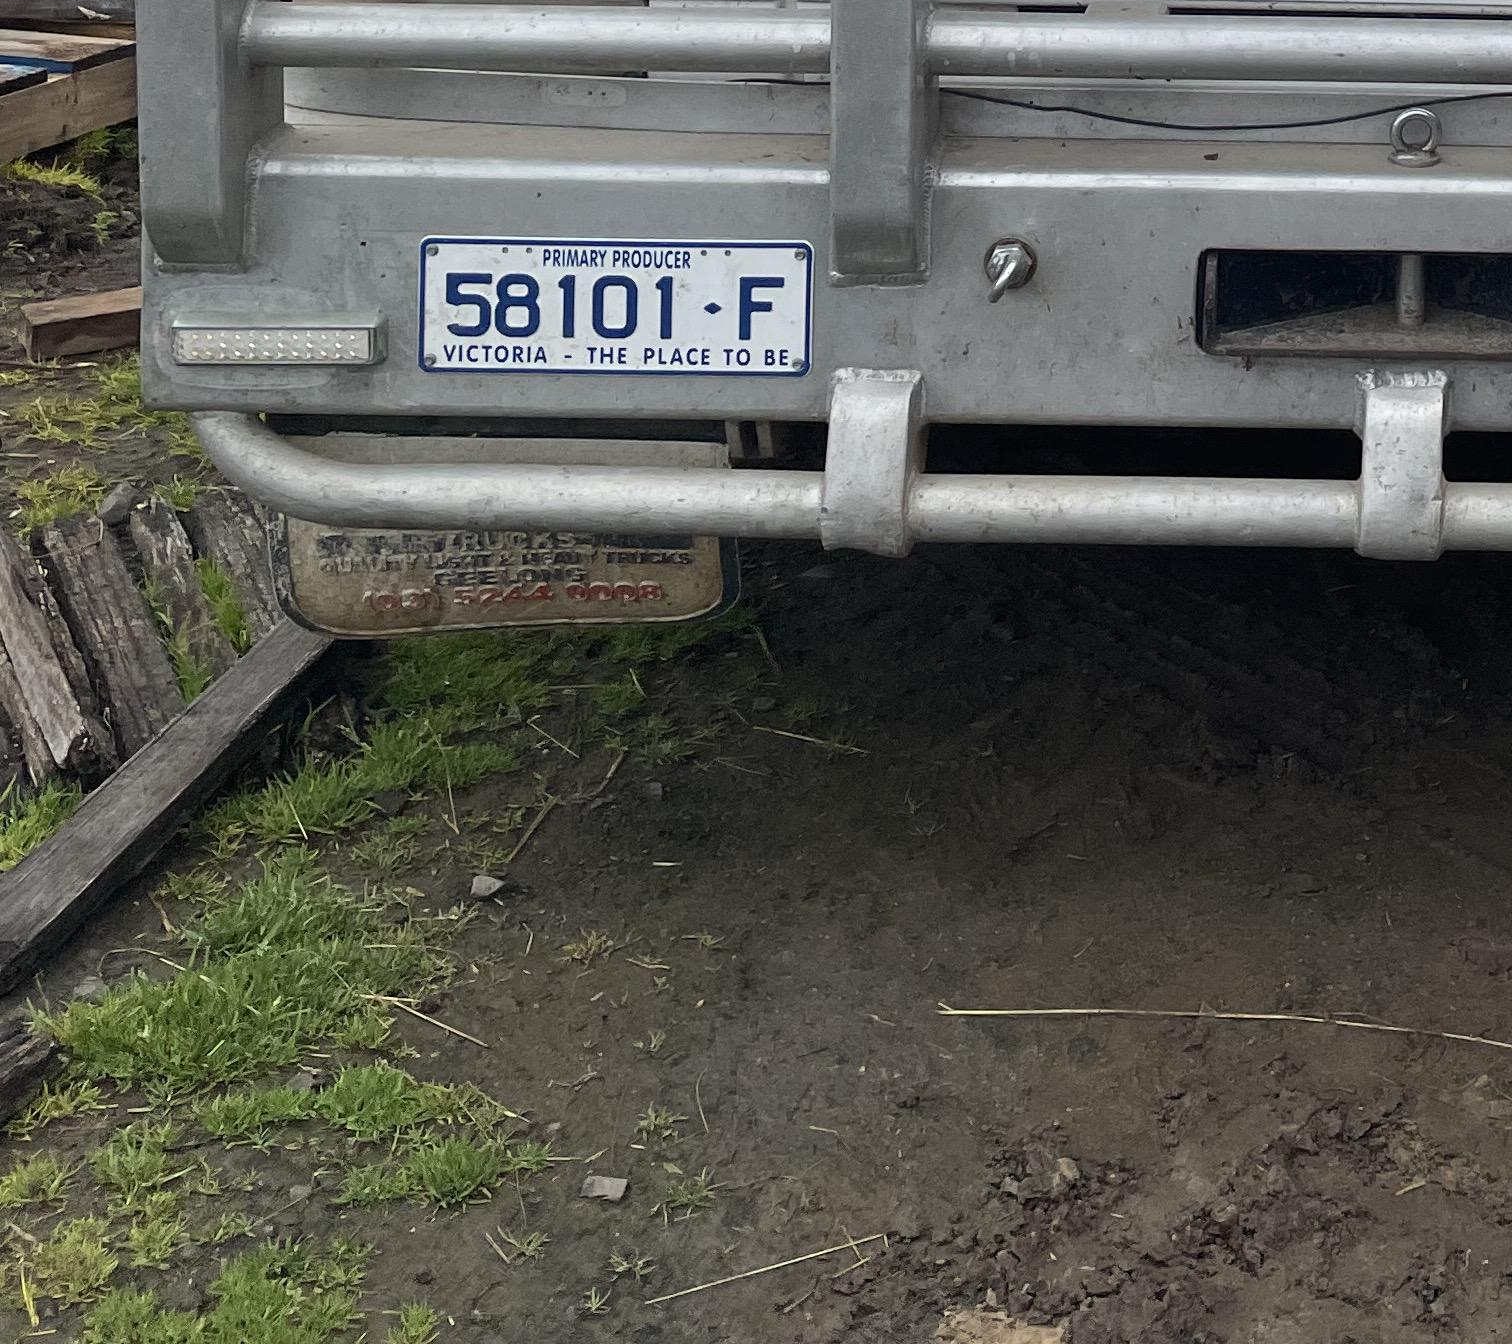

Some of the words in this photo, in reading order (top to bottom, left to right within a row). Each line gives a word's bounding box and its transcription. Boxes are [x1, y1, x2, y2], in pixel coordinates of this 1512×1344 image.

[542, 249, 606, 268] PRIMARY
[612, 250, 691, 270] PRODUCER
[443, 344, 548, 364] VICTORIA
[588, 346, 627, 365] THE
[643, 348, 711, 367] PLACE
[723, 349, 751, 367] TO
[764, 349, 789, 367] BE
